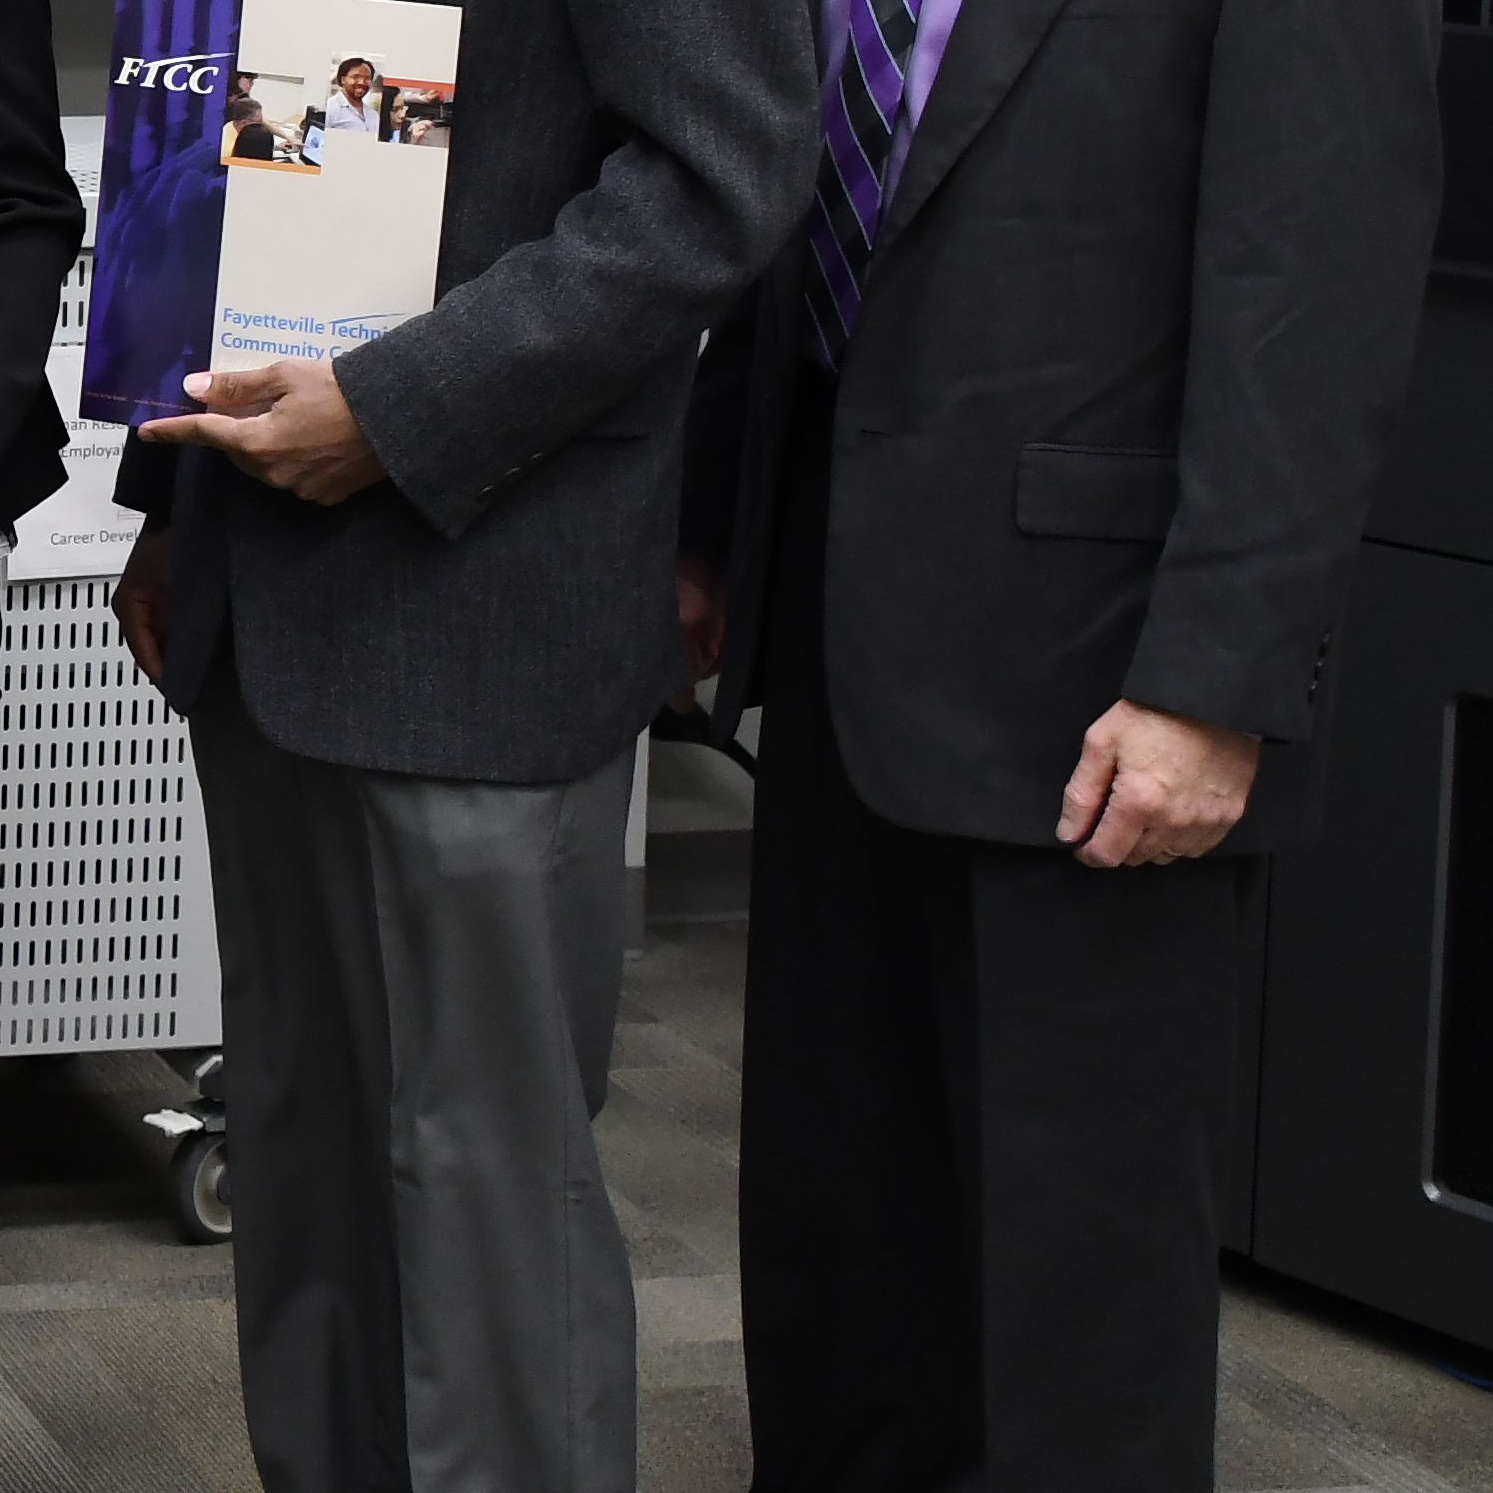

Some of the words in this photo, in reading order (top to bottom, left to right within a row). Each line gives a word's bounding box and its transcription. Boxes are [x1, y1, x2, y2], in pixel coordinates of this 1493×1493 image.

[114, 53, 233, 95] FTCC
[223, 307, 325, 335] Fayetteville
[220, 332, 325, 360] Community
[50, 532, 96, 546] Career
